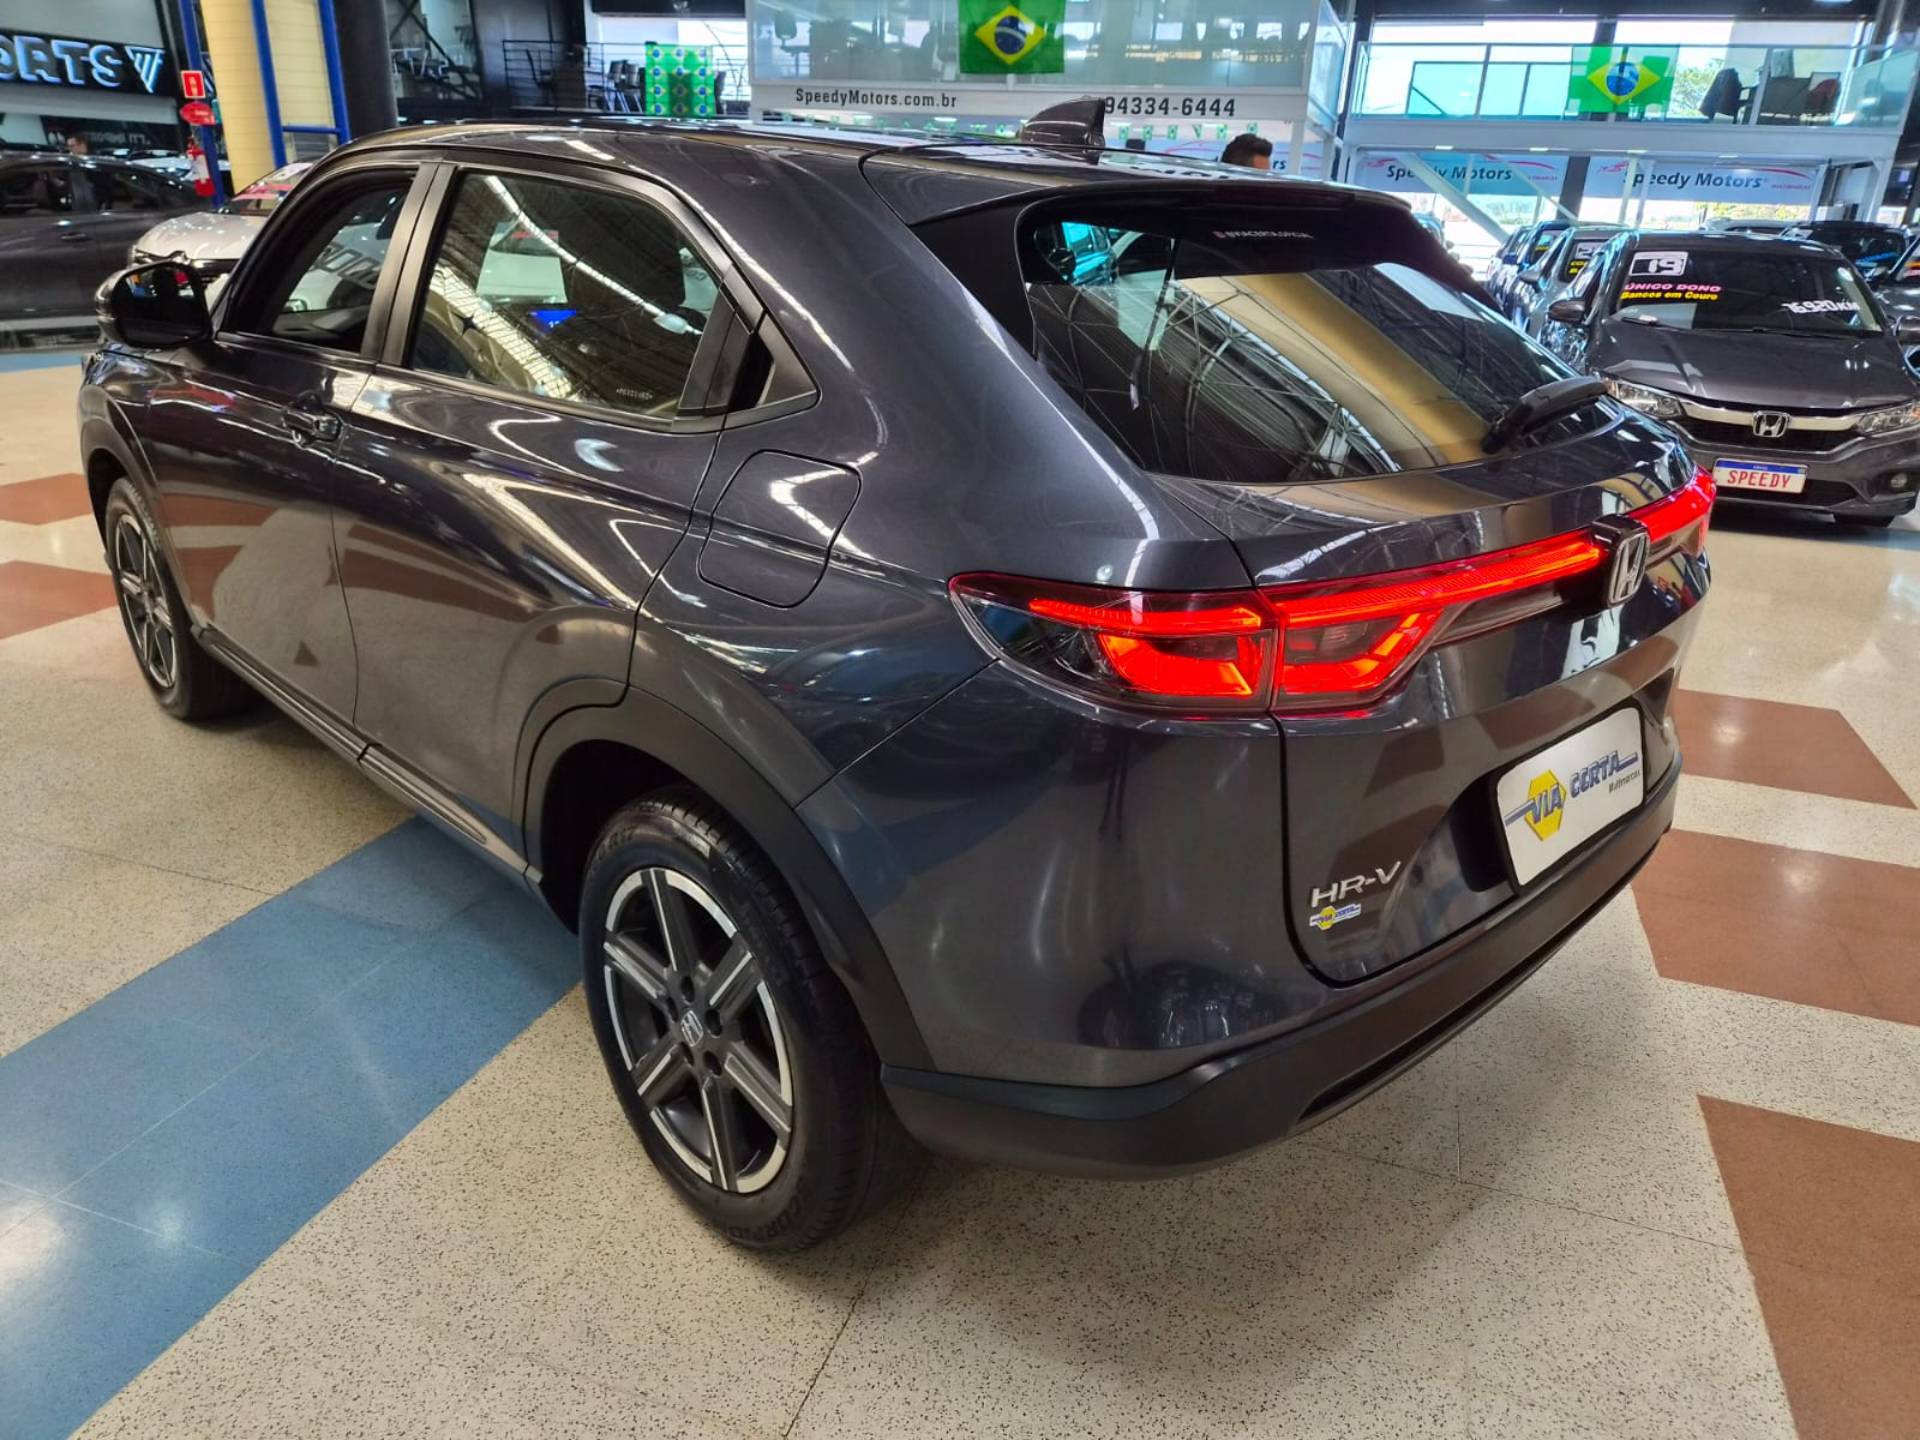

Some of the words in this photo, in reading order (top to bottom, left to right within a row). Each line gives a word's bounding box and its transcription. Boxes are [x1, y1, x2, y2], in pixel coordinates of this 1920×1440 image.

[796, 88, 957, 107] SpeedyMotors.com.br
[1104, 96, 1236, 117] 94334-6444
[1387, 164, 1446, 182] Spey
[1623, 170, 1690, 189] peedy
[1695, 172, 1763, 189] Motors
[1675, 283, 1722, 292] DONO
[1728, 469, 1791, 488] SPEEDY
[1530, 783, 1563, 825] VIA
[1570, 750, 1620, 798] CERTA
[1311, 861, 1401, 907] HR-V
